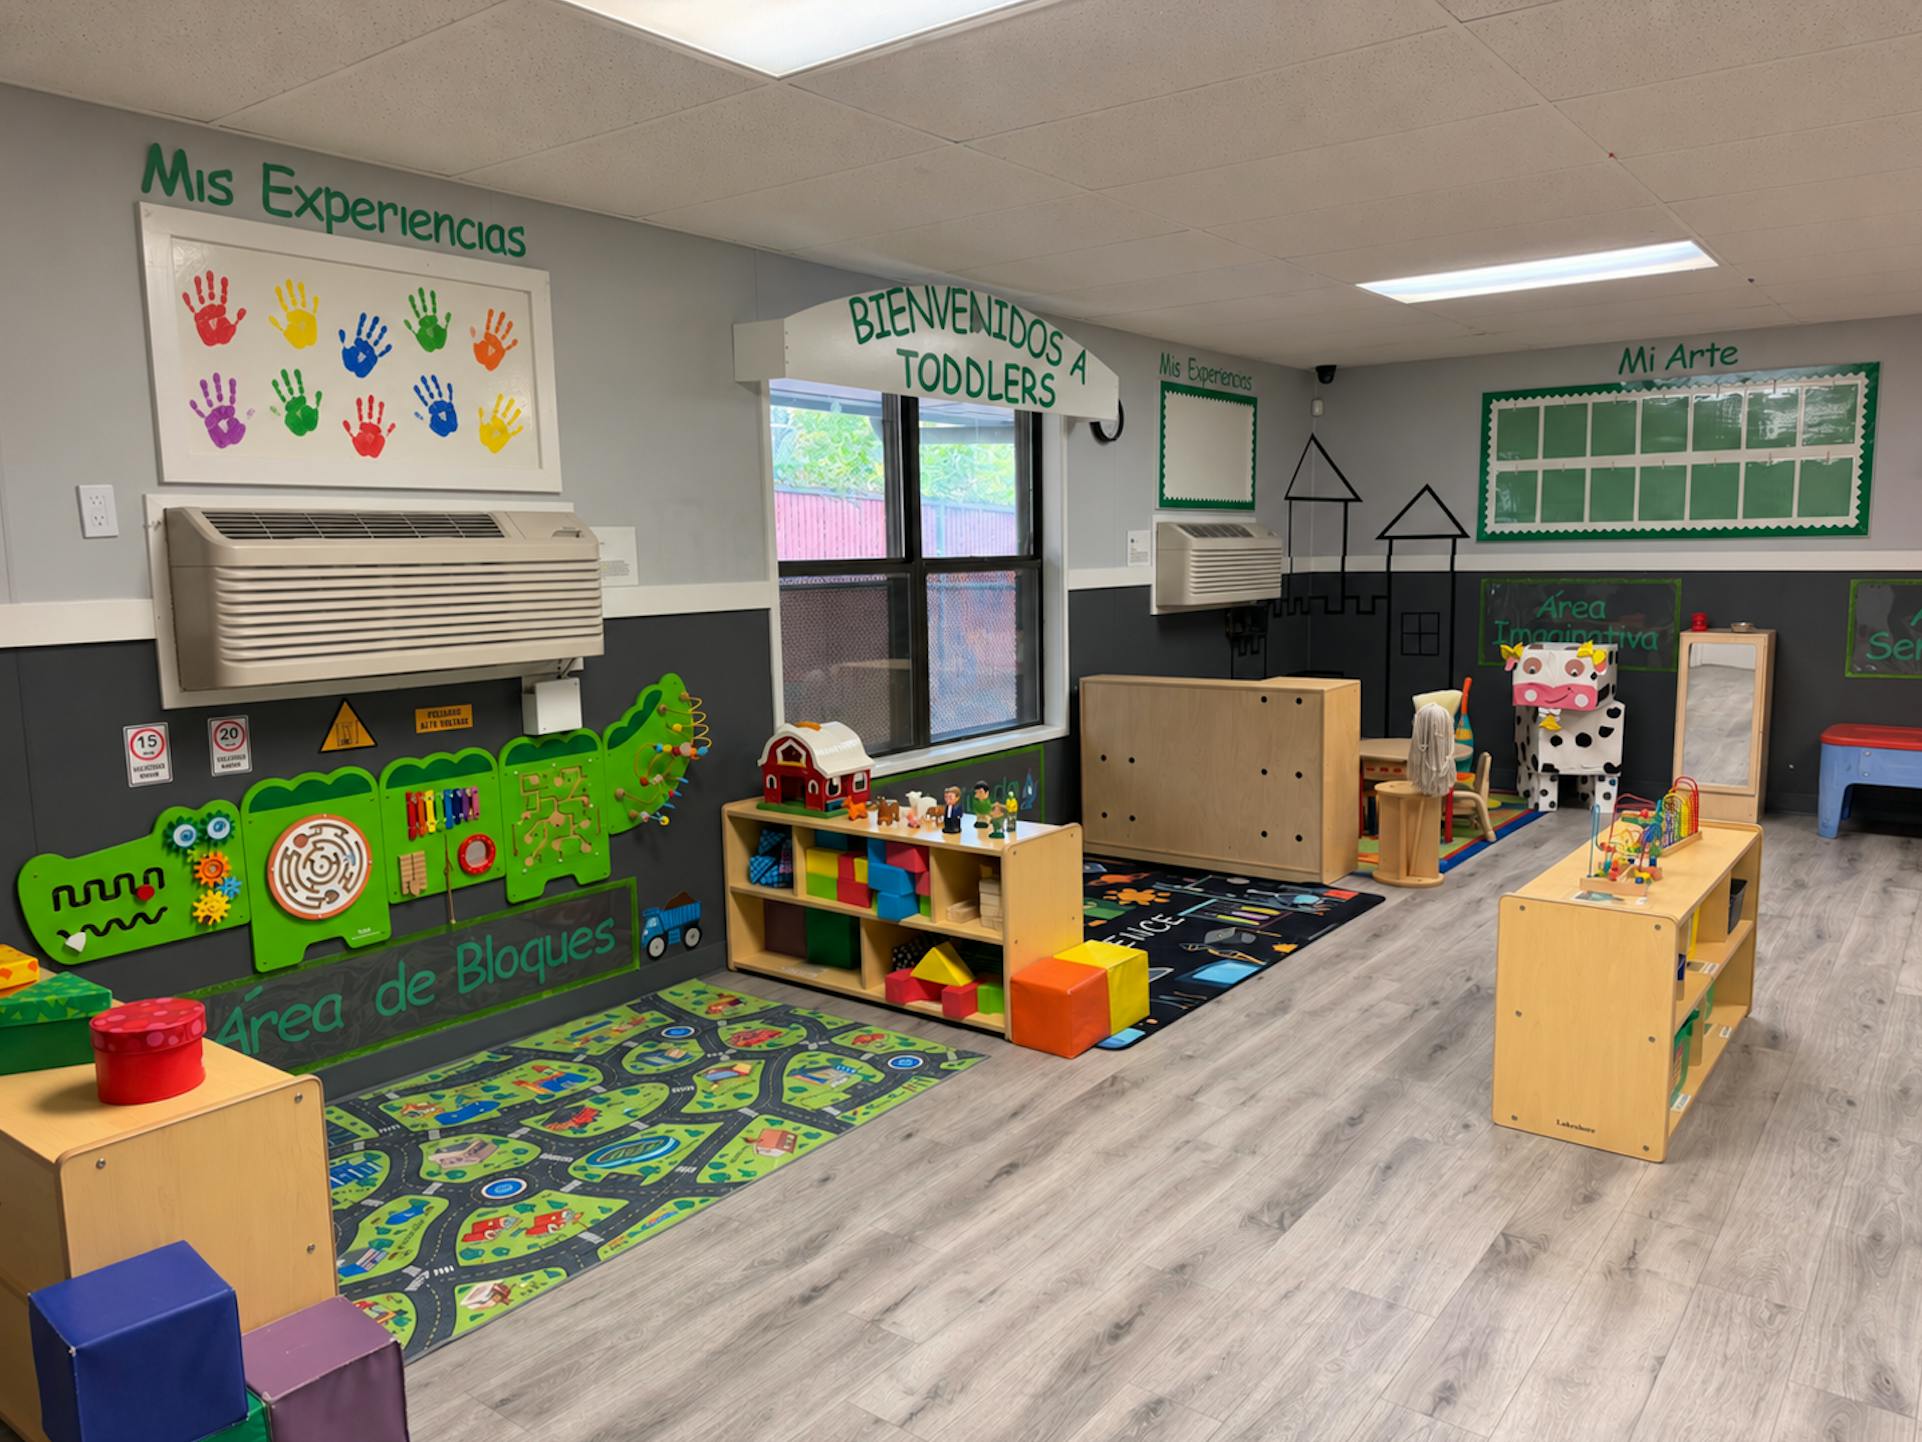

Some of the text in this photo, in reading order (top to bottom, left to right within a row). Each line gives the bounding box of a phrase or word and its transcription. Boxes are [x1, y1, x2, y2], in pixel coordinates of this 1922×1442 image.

[141, 142, 526, 258] Mis Experiencias
[848, 285, 1087, 385] BIENVENIDOS A
[896, 348, 1056, 408] TODDLERS
[1160, 352, 1253, 391] Mis Experiencias
[1618, 342, 1739, 375] Mi Arte
[1536, 590, 1608, 620] Área
[137, 734, 158, 749] 15
[220, 727, 239, 741] 20
[215, 917, 616, 1055] Área de Bloques
